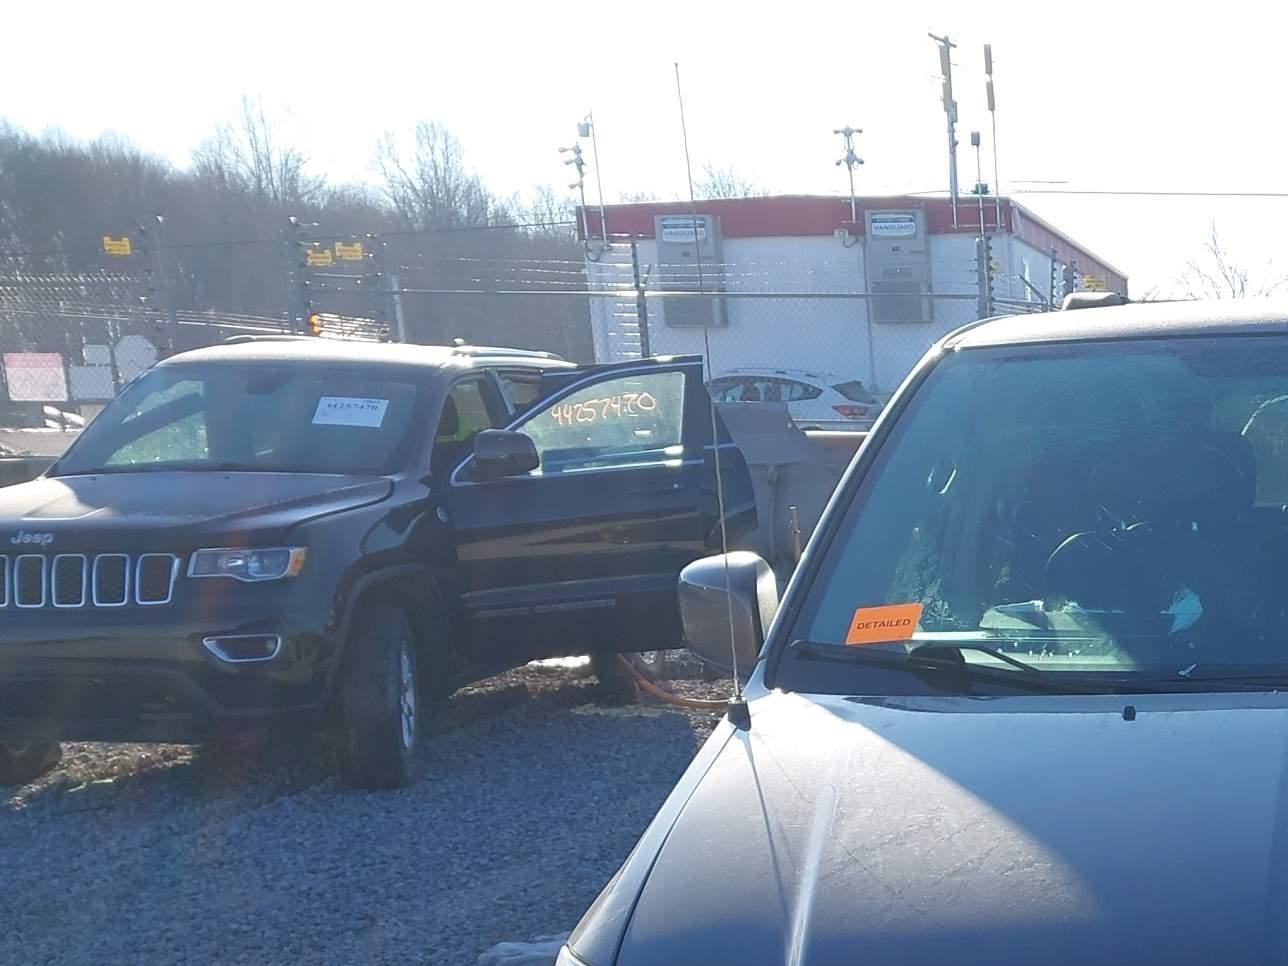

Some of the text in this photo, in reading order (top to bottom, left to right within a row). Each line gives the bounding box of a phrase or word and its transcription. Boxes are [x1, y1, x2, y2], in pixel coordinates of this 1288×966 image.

[873, 223, 915, 232] VANGUARD
[551, 391, 656, 425] 44257470
[10, 530, 54, 546] Jeep
[857, 618, 911, 630] DETAILED
